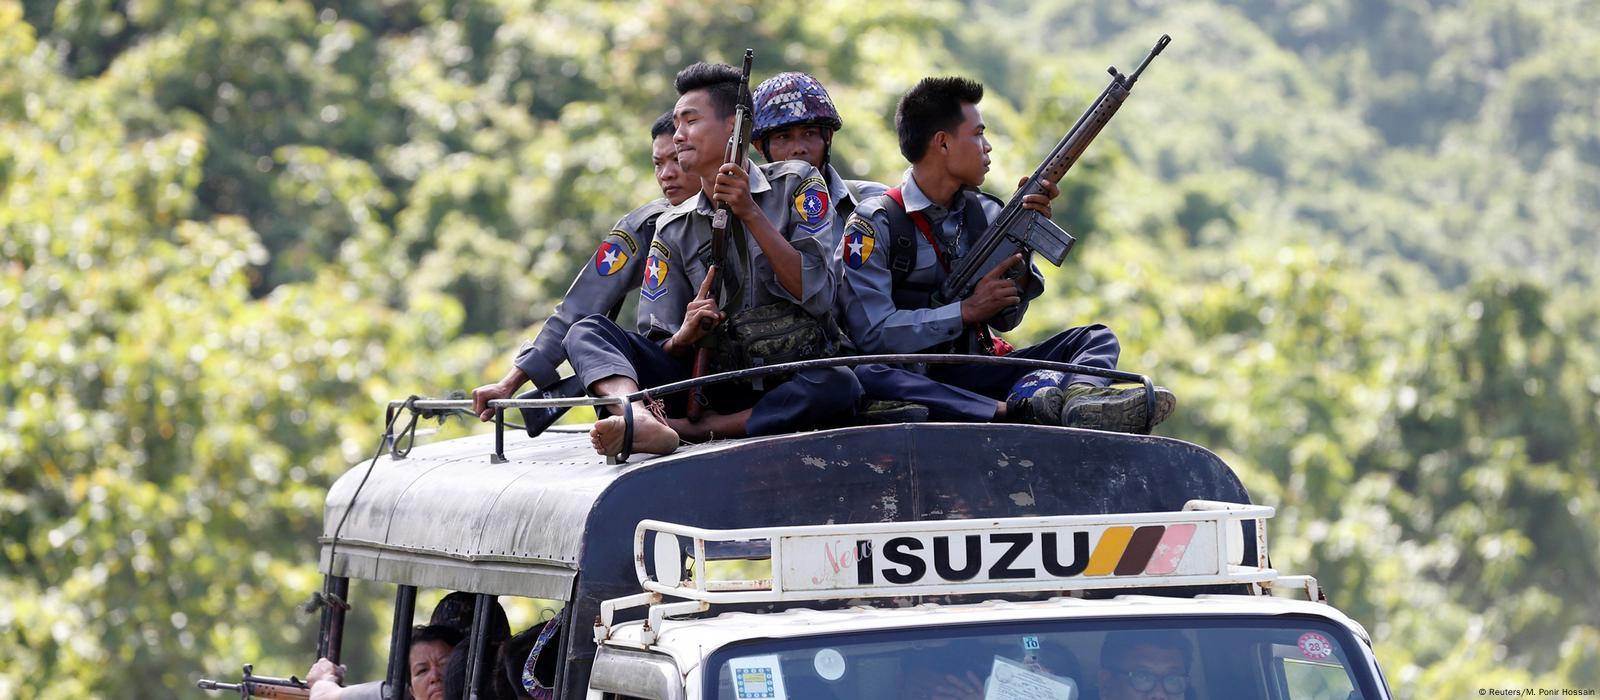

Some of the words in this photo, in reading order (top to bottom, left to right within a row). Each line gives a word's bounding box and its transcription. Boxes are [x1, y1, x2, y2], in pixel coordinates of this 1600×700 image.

[812, 539, 876, 584] New
[856, 531, 1089, 585] ISUZU
[1309, 643, 1321, 651] 28
